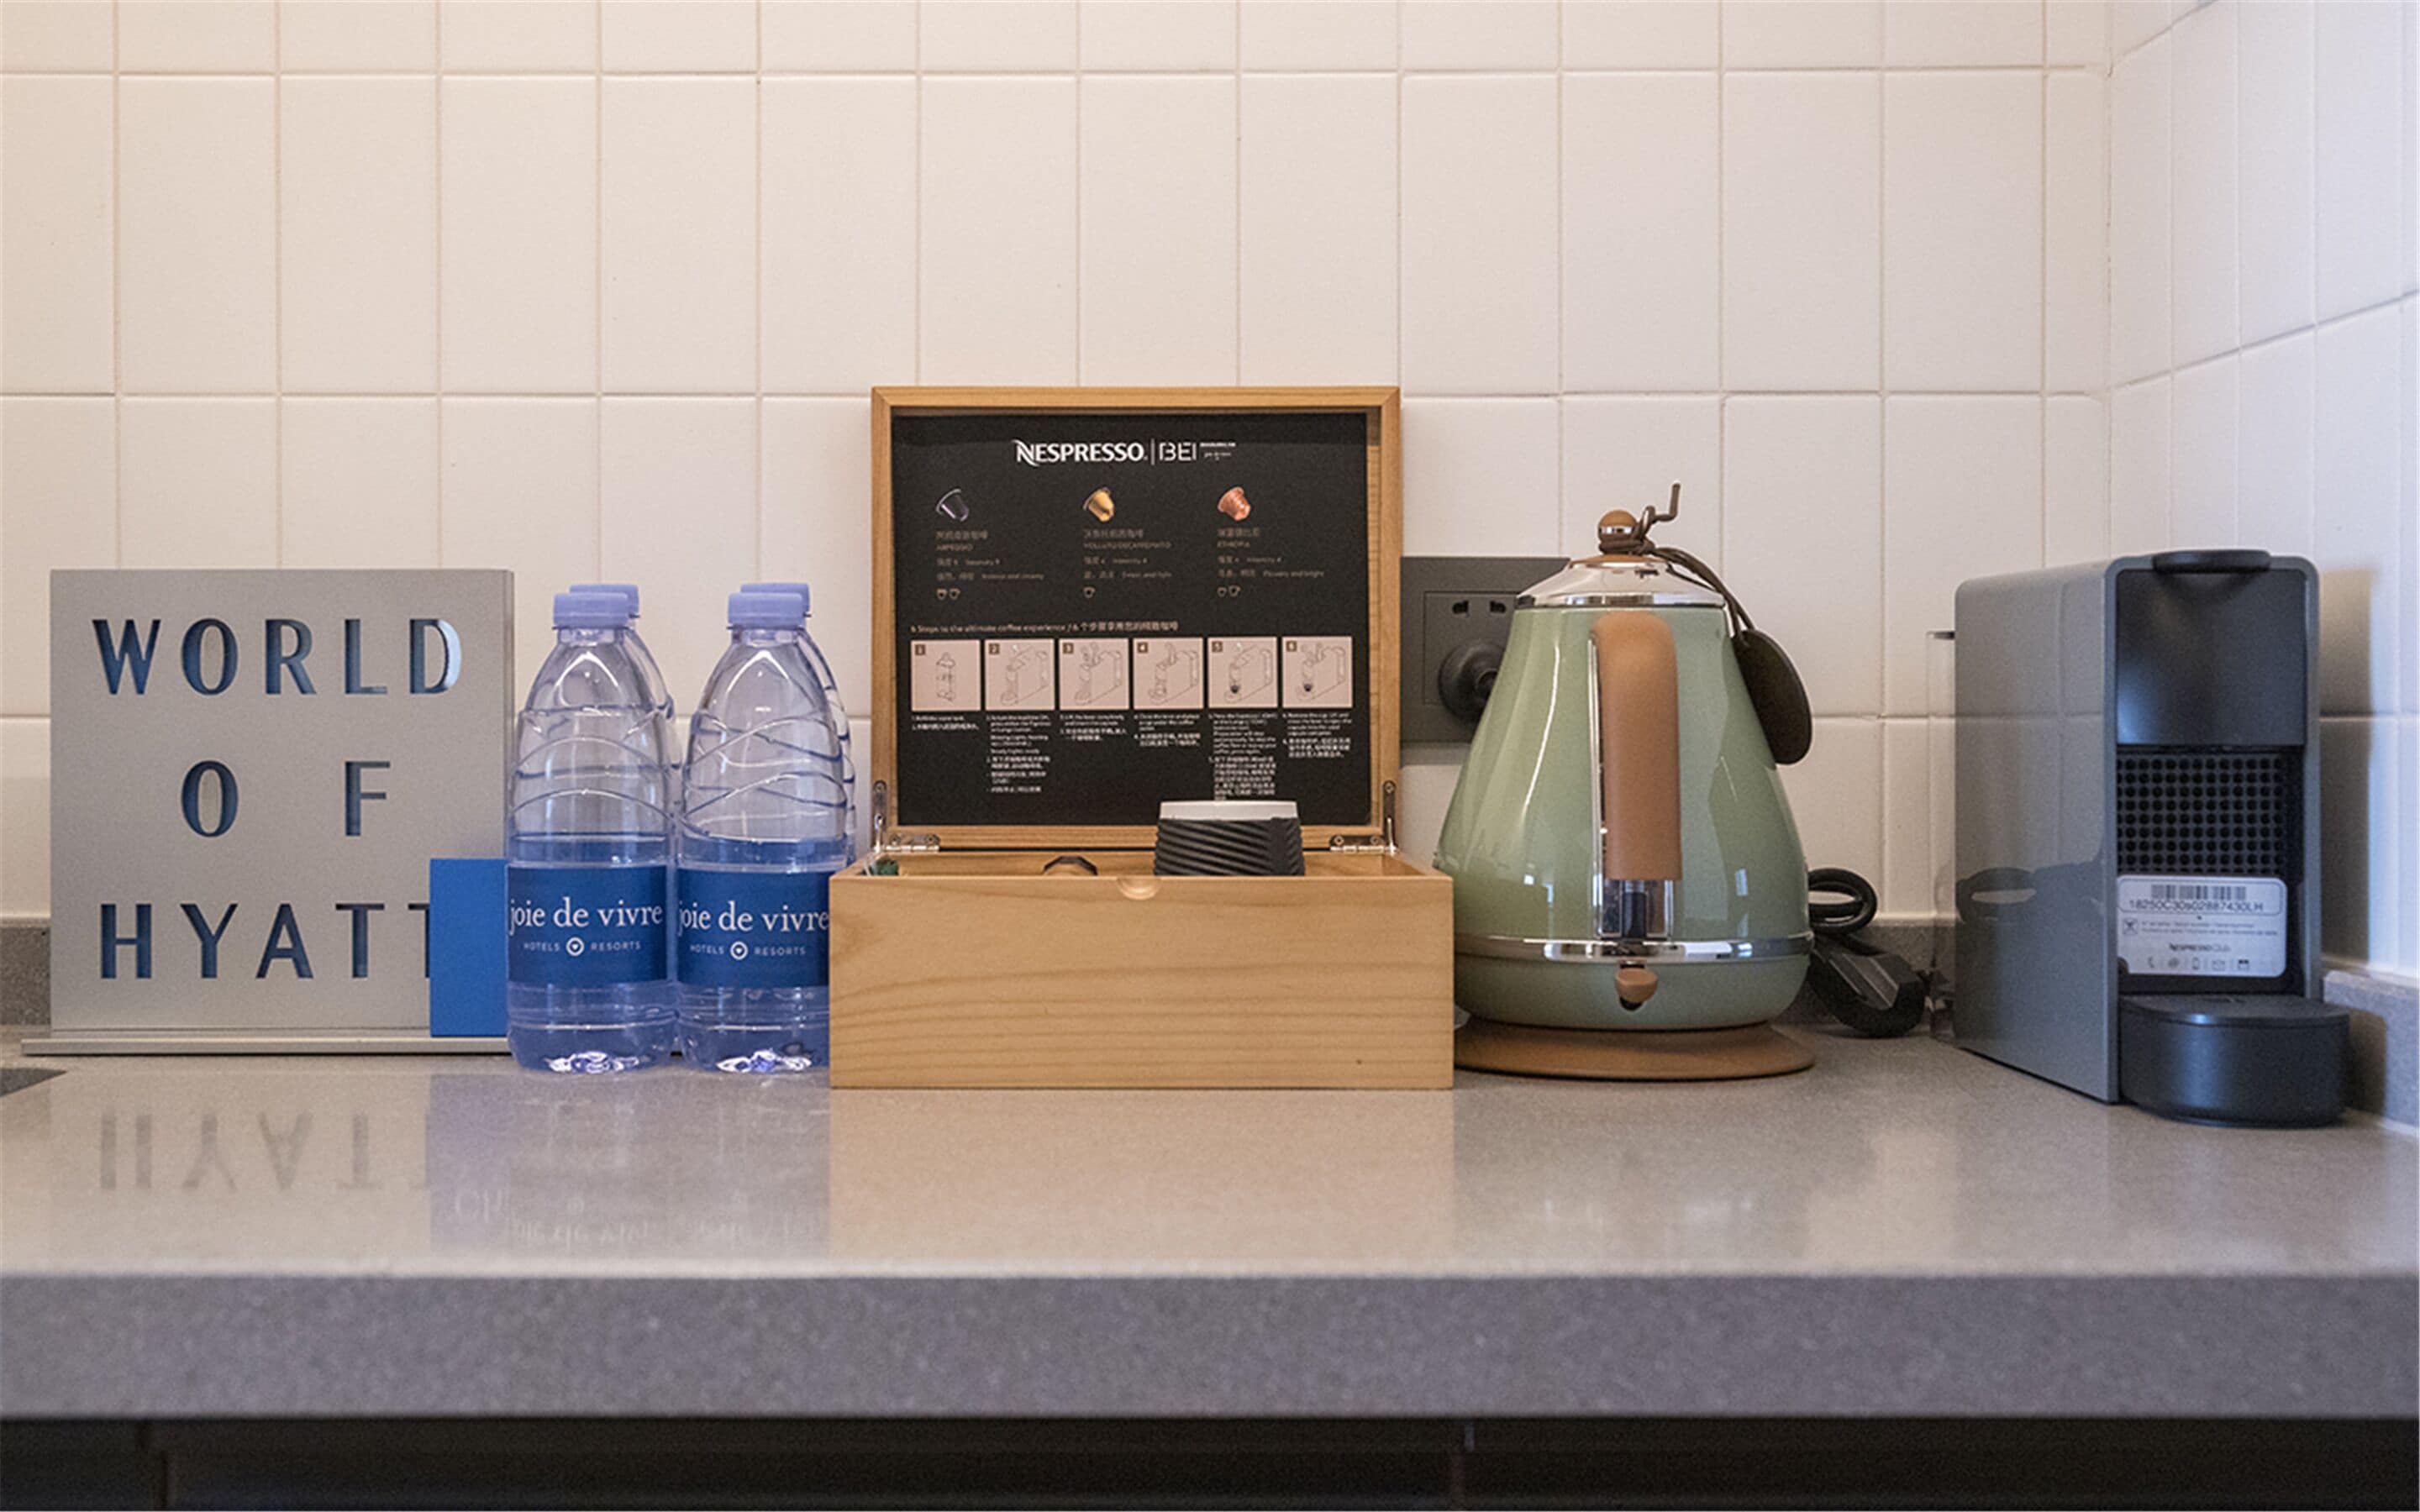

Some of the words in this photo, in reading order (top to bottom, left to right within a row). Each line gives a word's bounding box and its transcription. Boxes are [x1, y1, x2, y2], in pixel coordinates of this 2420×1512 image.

[1012, 439, 1145, 466] NESPRESSO
[92, 618, 461, 696] WORLD
[180, 759, 391, 837] OF
[508, 899, 546, 937] joie
[553, 895, 589, 928] de
[597, 899, 663, 927] vivre
[677, 900, 712, 937] joie
[718, 900, 754, 932] de
[762, 905, 829, 932] vivre
[523, 942, 560, 952] HOTELS
[590, 940, 641, 952] RESORTS
[690, 944, 725, 955] HOTELS
[754, 946, 807, 956] RESORTS
